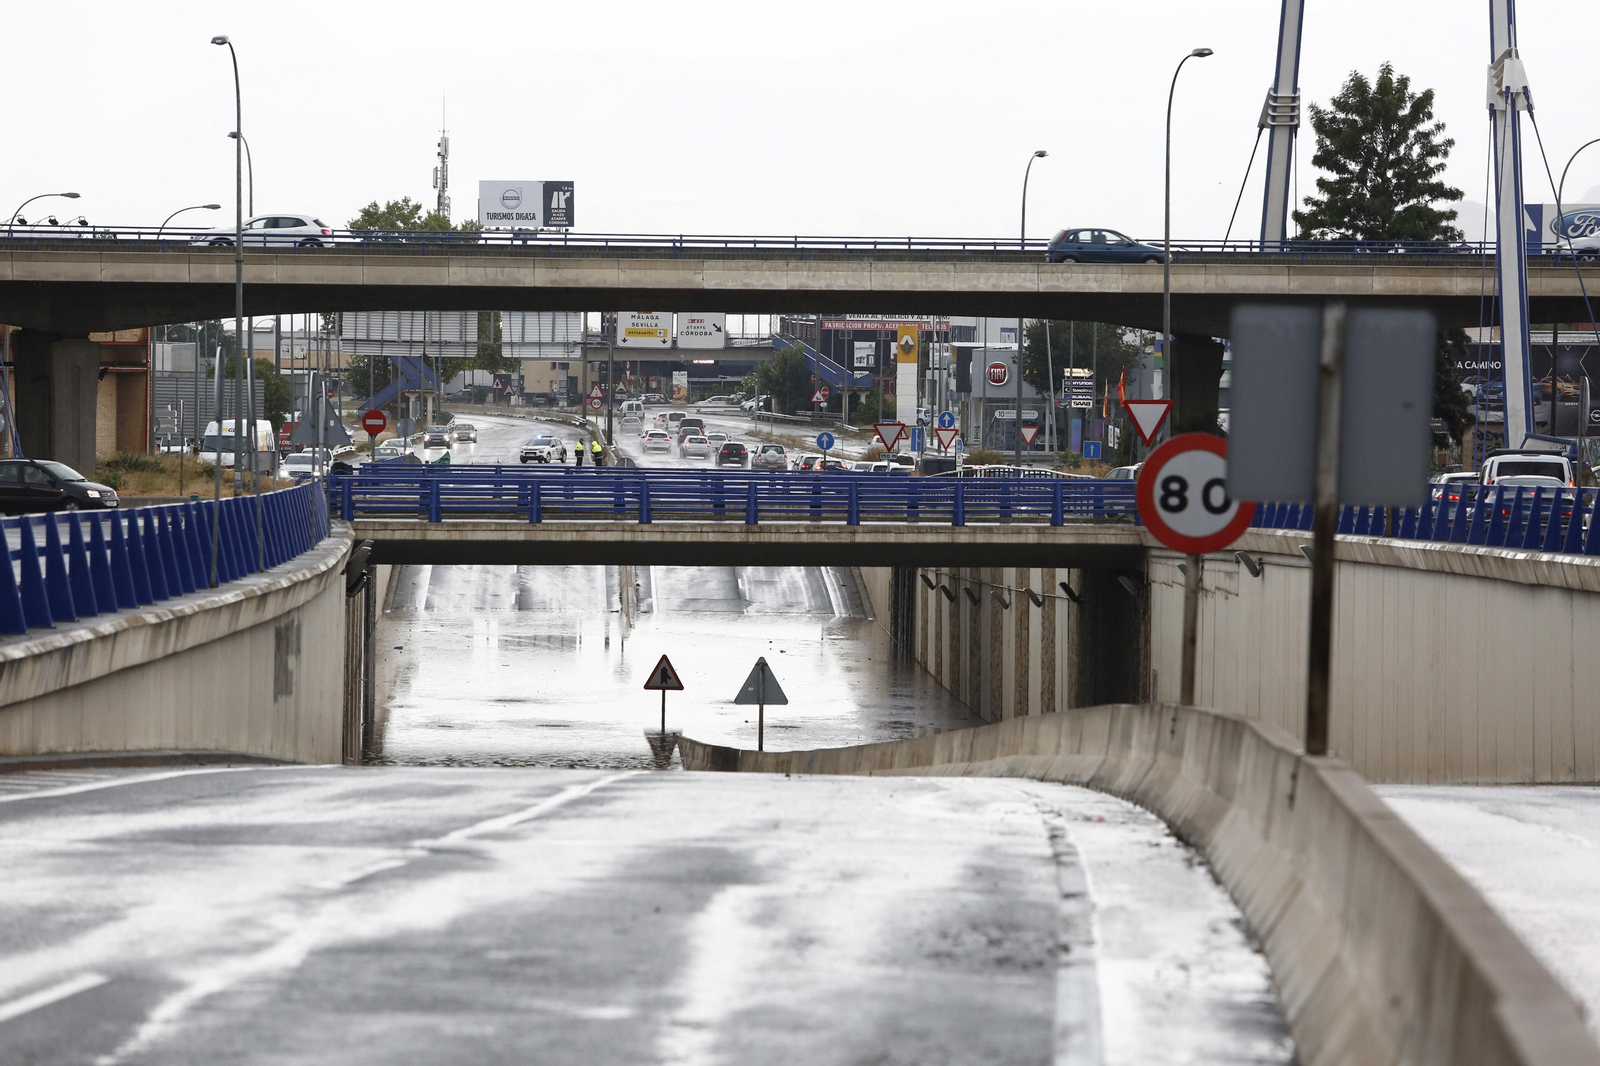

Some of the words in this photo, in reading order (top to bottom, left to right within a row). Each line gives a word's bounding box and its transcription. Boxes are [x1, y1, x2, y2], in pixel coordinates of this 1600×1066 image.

[486, 212, 514, 220] TURISMOS
[516, 212, 536, 220] DIGASA
[1464, 360, 1502, 370] CAMINO
[990, 368, 1006, 380] FIAT
[1160, 474, 1232, 516] 80
